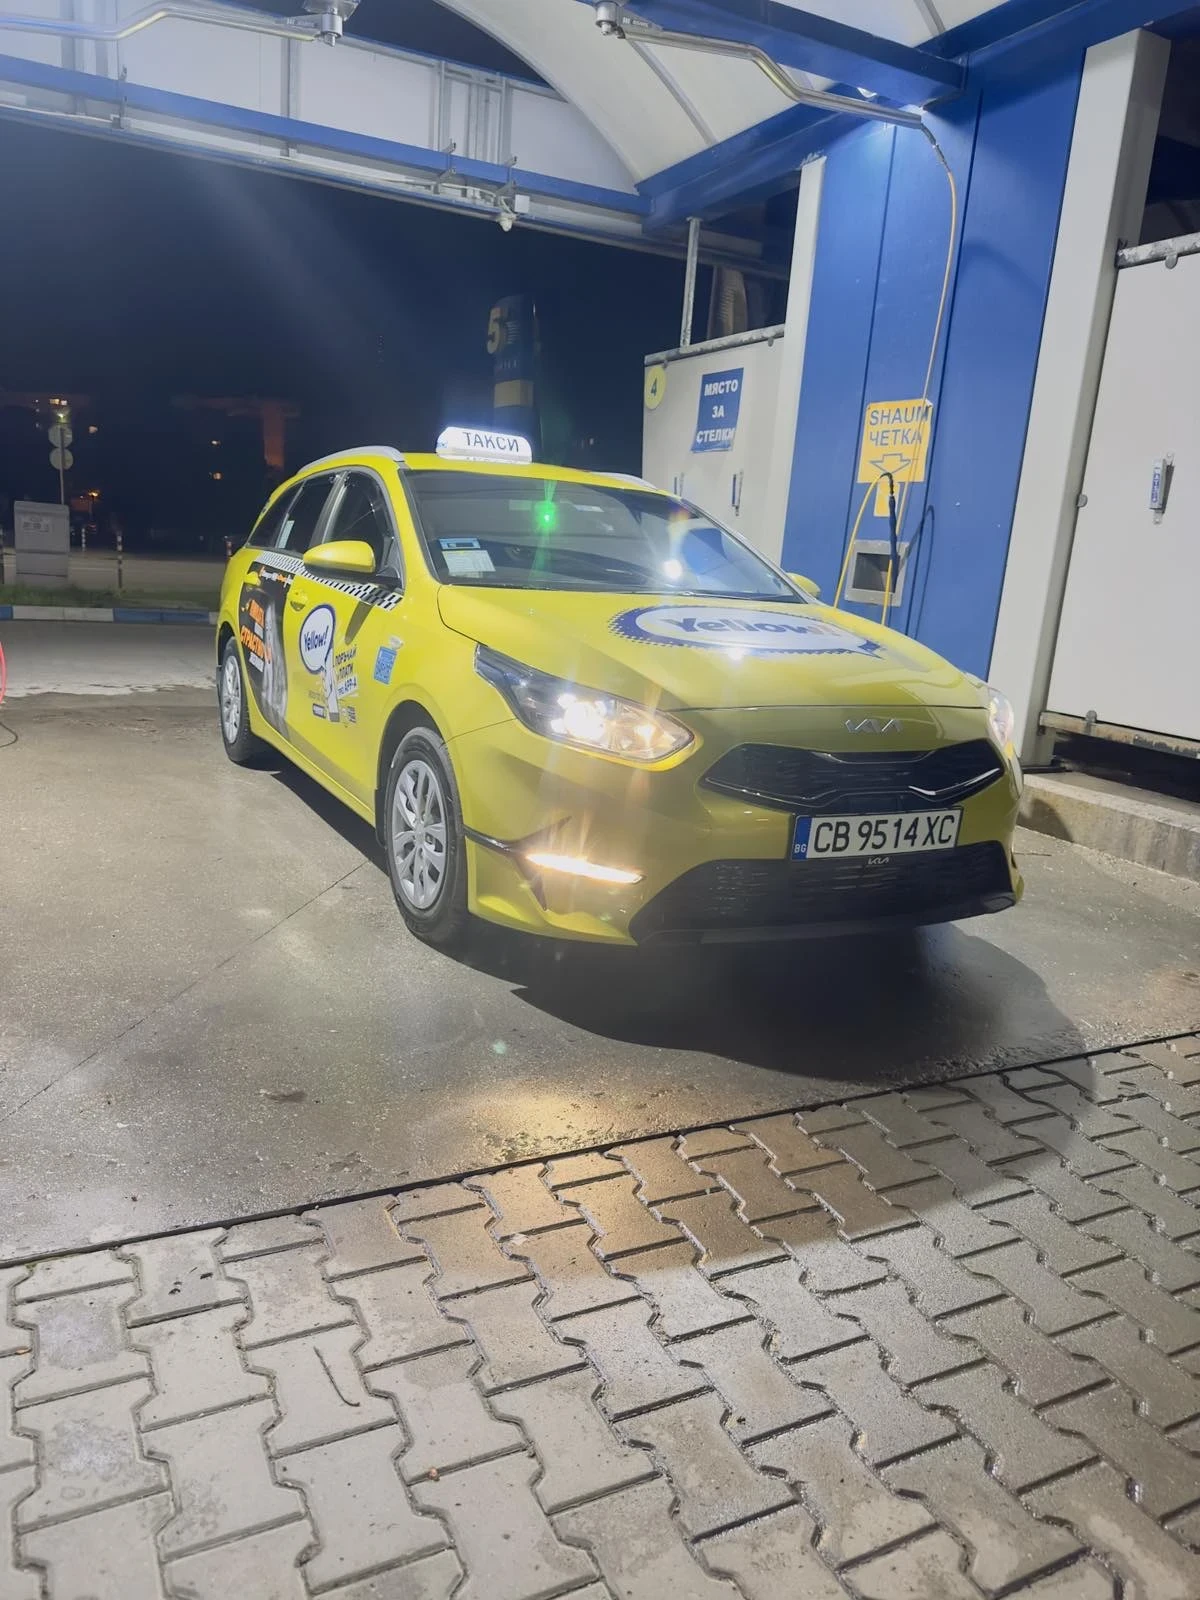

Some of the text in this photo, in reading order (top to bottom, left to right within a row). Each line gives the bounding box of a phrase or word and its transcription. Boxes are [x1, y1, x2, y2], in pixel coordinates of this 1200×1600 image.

[650, 377, 658, 397] 4
[704, 379, 739, 397] МЯСТО
[711, 405, 725, 419] ЗА
[463, 431, 519, 453] ТАКСИ
[696, 427, 736, 444] СТЕЛКИ
[869, 427, 922, 447] ЧЕТКА
[303, 624, 329, 652] Yellow!
[813, 814, 955, 854] CB 9514 XC
[794, 843, 807, 854] BG
